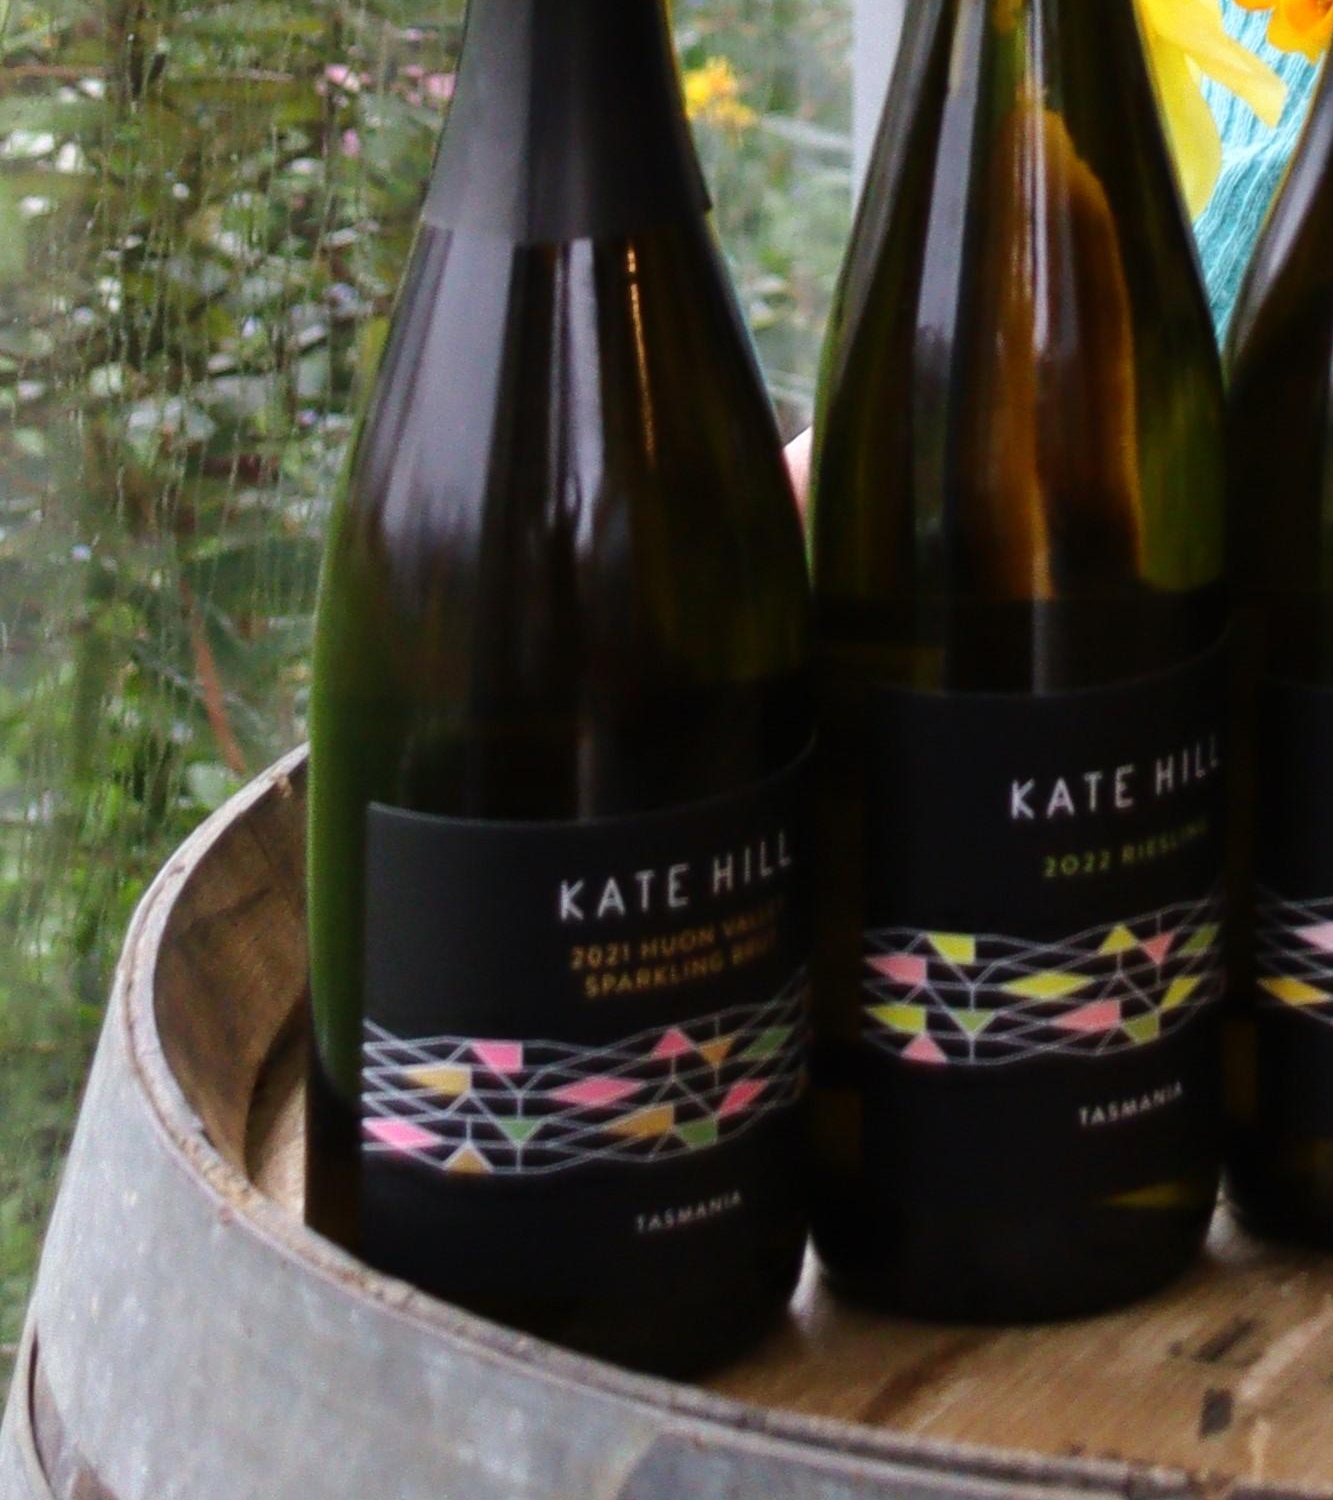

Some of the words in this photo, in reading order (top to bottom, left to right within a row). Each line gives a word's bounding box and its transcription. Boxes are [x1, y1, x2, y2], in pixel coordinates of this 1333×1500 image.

[1010, 763, 1136, 821] KATE
[1154, 735, 1219, 798] HILL
[558, 862, 690, 924] KATE
[711, 828, 793, 896] HILL
[1041, 848, 1111, 879] 2022
[640, 922, 716, 961] HUON
[584, 947, 724, 1000] SPARKLING
[1079, 1081, 1185, 1128] TASMANIA
[634, 1190, 742, 1235] TASMANIA
